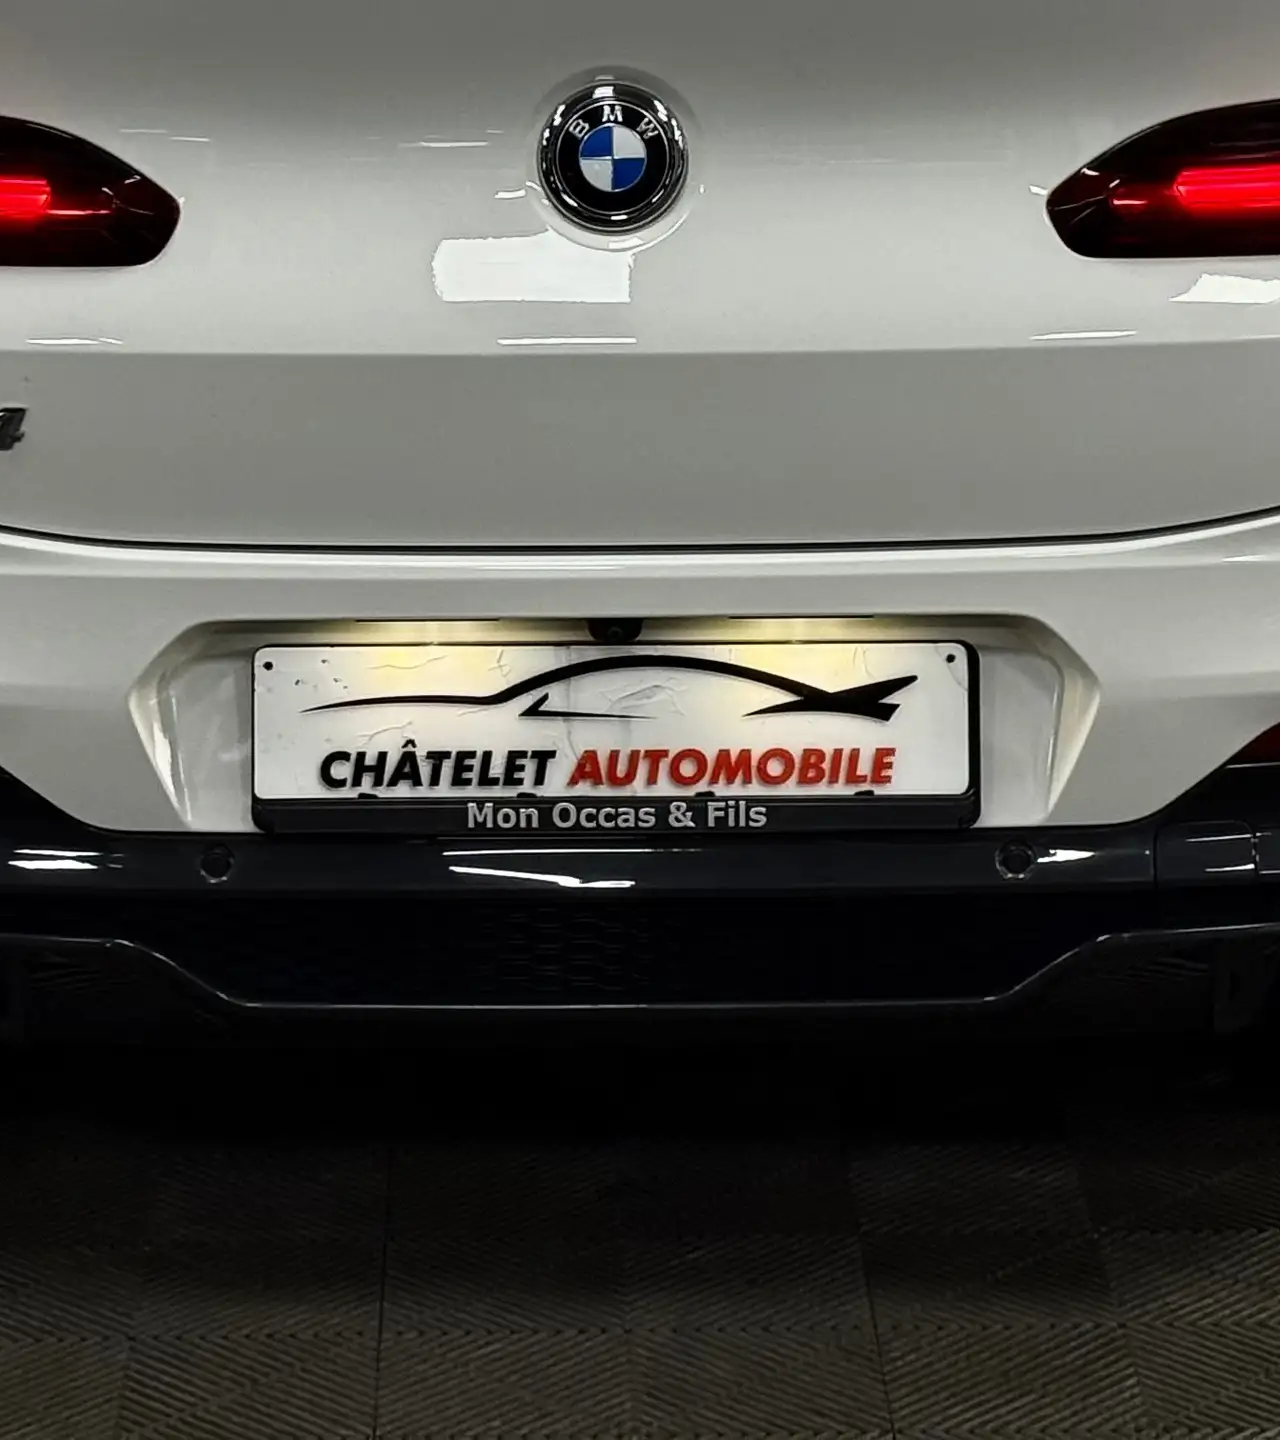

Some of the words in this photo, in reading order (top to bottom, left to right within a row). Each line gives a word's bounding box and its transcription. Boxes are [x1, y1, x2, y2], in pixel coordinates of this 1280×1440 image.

[569, 105, 659, 139] BMW
[319, 739, 557, 789] CHÂTELET
[567, 747, 897, 788] AUTOMOBILE
[467, 801, 538, 830] Mon
[552, 801, 657, 830] Occas
[668, 801, 697, 829] &
[707, 800, 768, 829] Fils
